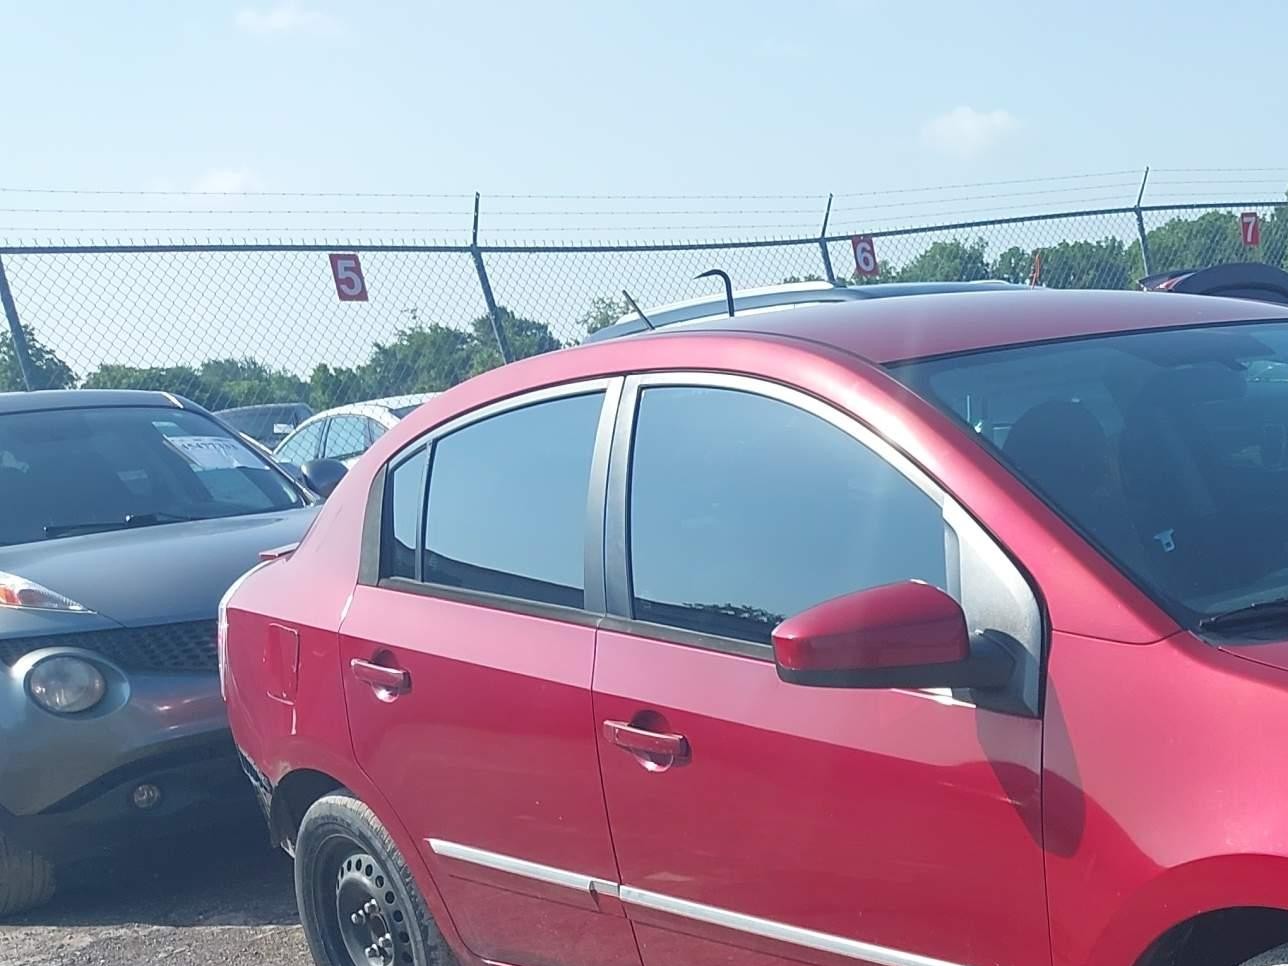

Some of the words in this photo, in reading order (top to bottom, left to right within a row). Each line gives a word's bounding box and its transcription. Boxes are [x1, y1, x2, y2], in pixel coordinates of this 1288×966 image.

[1243, 216, 1256, 242] 7
[856, 242, 874, 271] 6
[337, 260, 362, 295] 5
